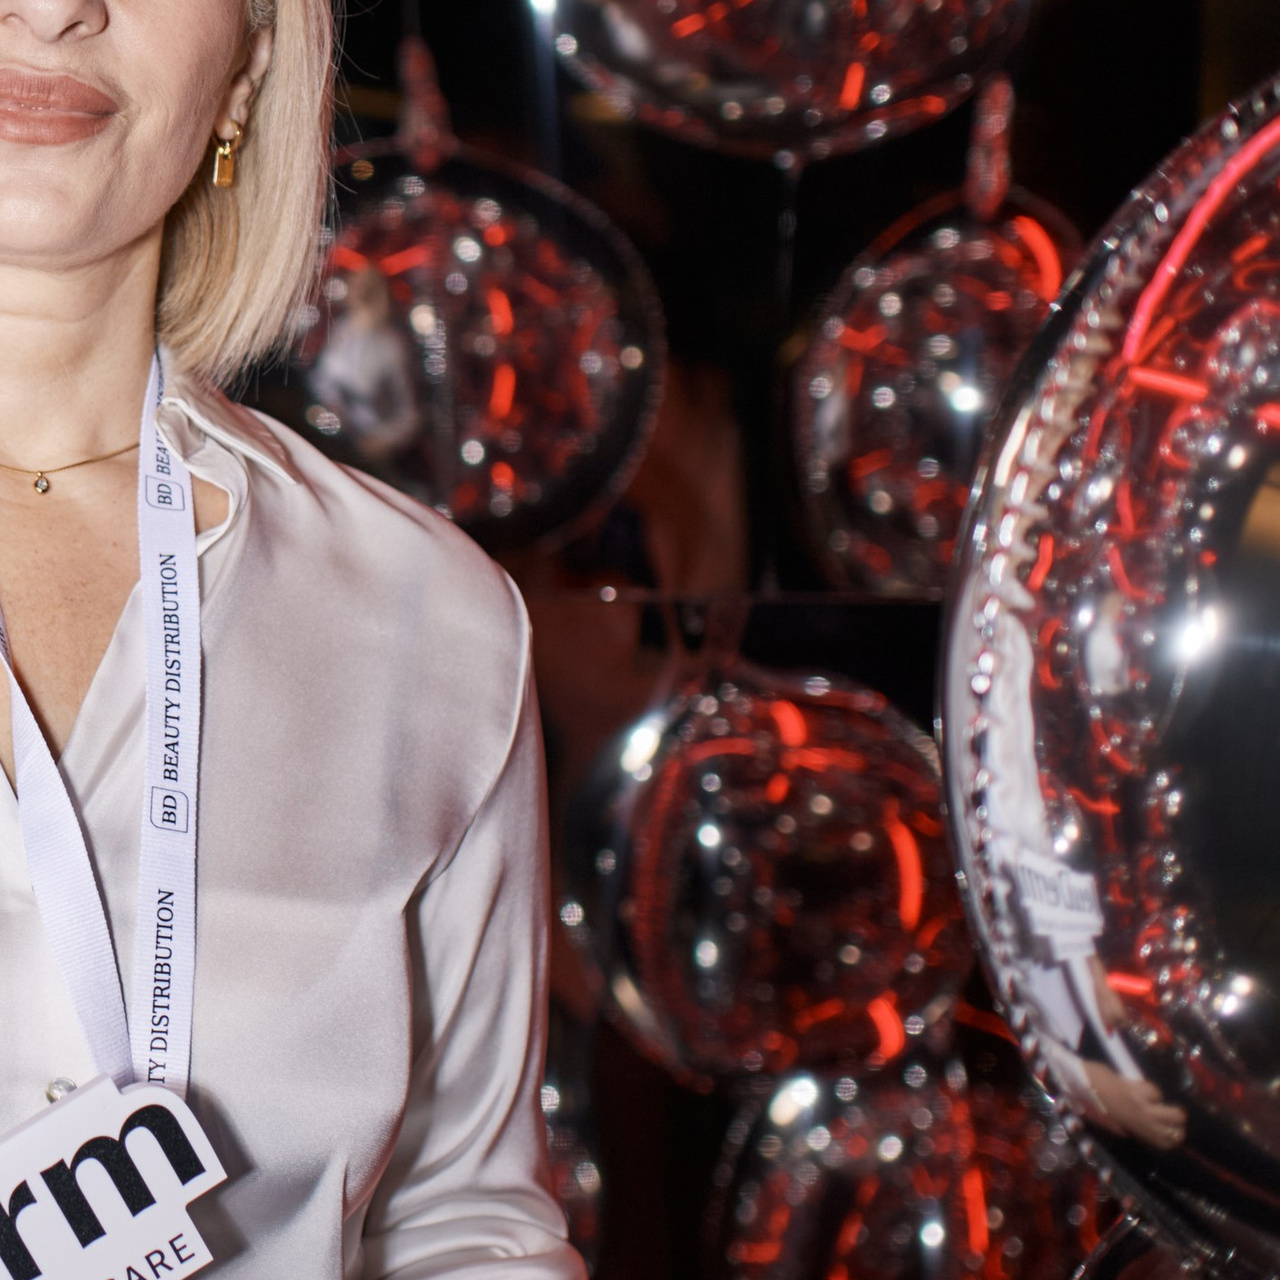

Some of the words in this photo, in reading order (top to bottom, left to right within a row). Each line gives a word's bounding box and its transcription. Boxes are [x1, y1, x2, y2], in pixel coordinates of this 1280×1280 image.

[157, 483, 173, 506] BD
[159, 553, 181, 693] DISTRIBUTION
[162, 696, 181, 783] BEAUTY
[161, 794, 178, 826] BD
[149, 888, 175, 1052] DISTRIBUTION
